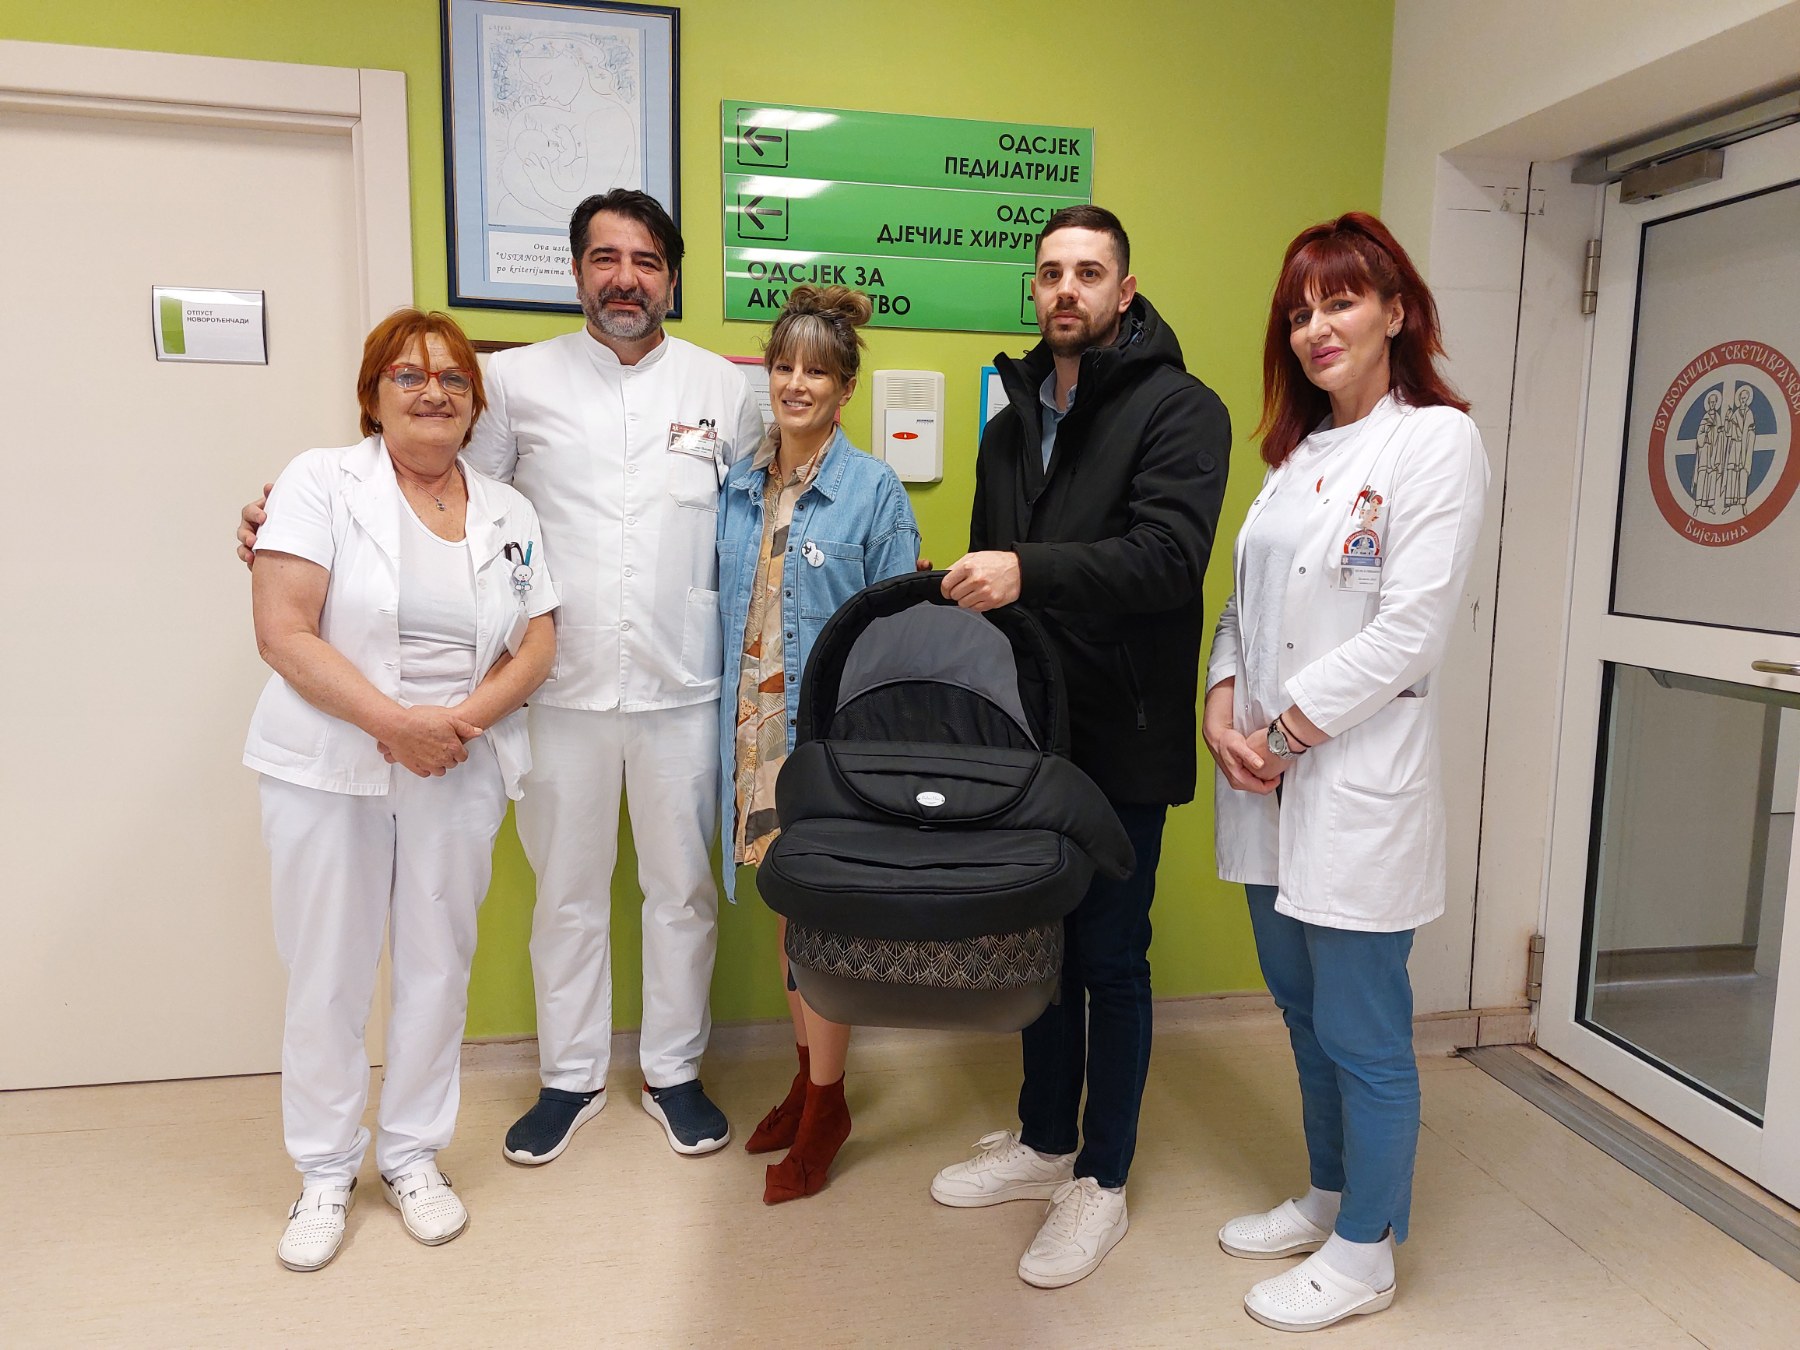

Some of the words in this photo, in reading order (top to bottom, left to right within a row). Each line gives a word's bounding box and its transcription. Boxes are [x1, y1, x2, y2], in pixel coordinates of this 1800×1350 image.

[998, 133, 1081, 156] ОДСЈЕК
[945, 156, 1080, 183] ПЕДИЈАТРИЈЕ
[996, 205, 1064, 226] ОДСЈ
[533, 243, 549, 251] Ova
[552, 244, 571, 252] usta
[876, 223, 964, 246] ДЈЕЧИЈЕ
[968, 229, 1042, 250] ХИРУРГ
[496, 266, 507, 274] po
[509, 265, 565, 276] kriterijumima
[553, 256, 572, 265] PRI
[747, 260, 847, 285] ОДСЈЕК
[854, 266, 885, 287] ЗА
[186, 316, 250, 325] НОВОРОЂЕНЧАДИ
[1654, 406, 1670, 434] ЈЗУ
[1665, 351, 1719, 408] БОЛНИЦА
